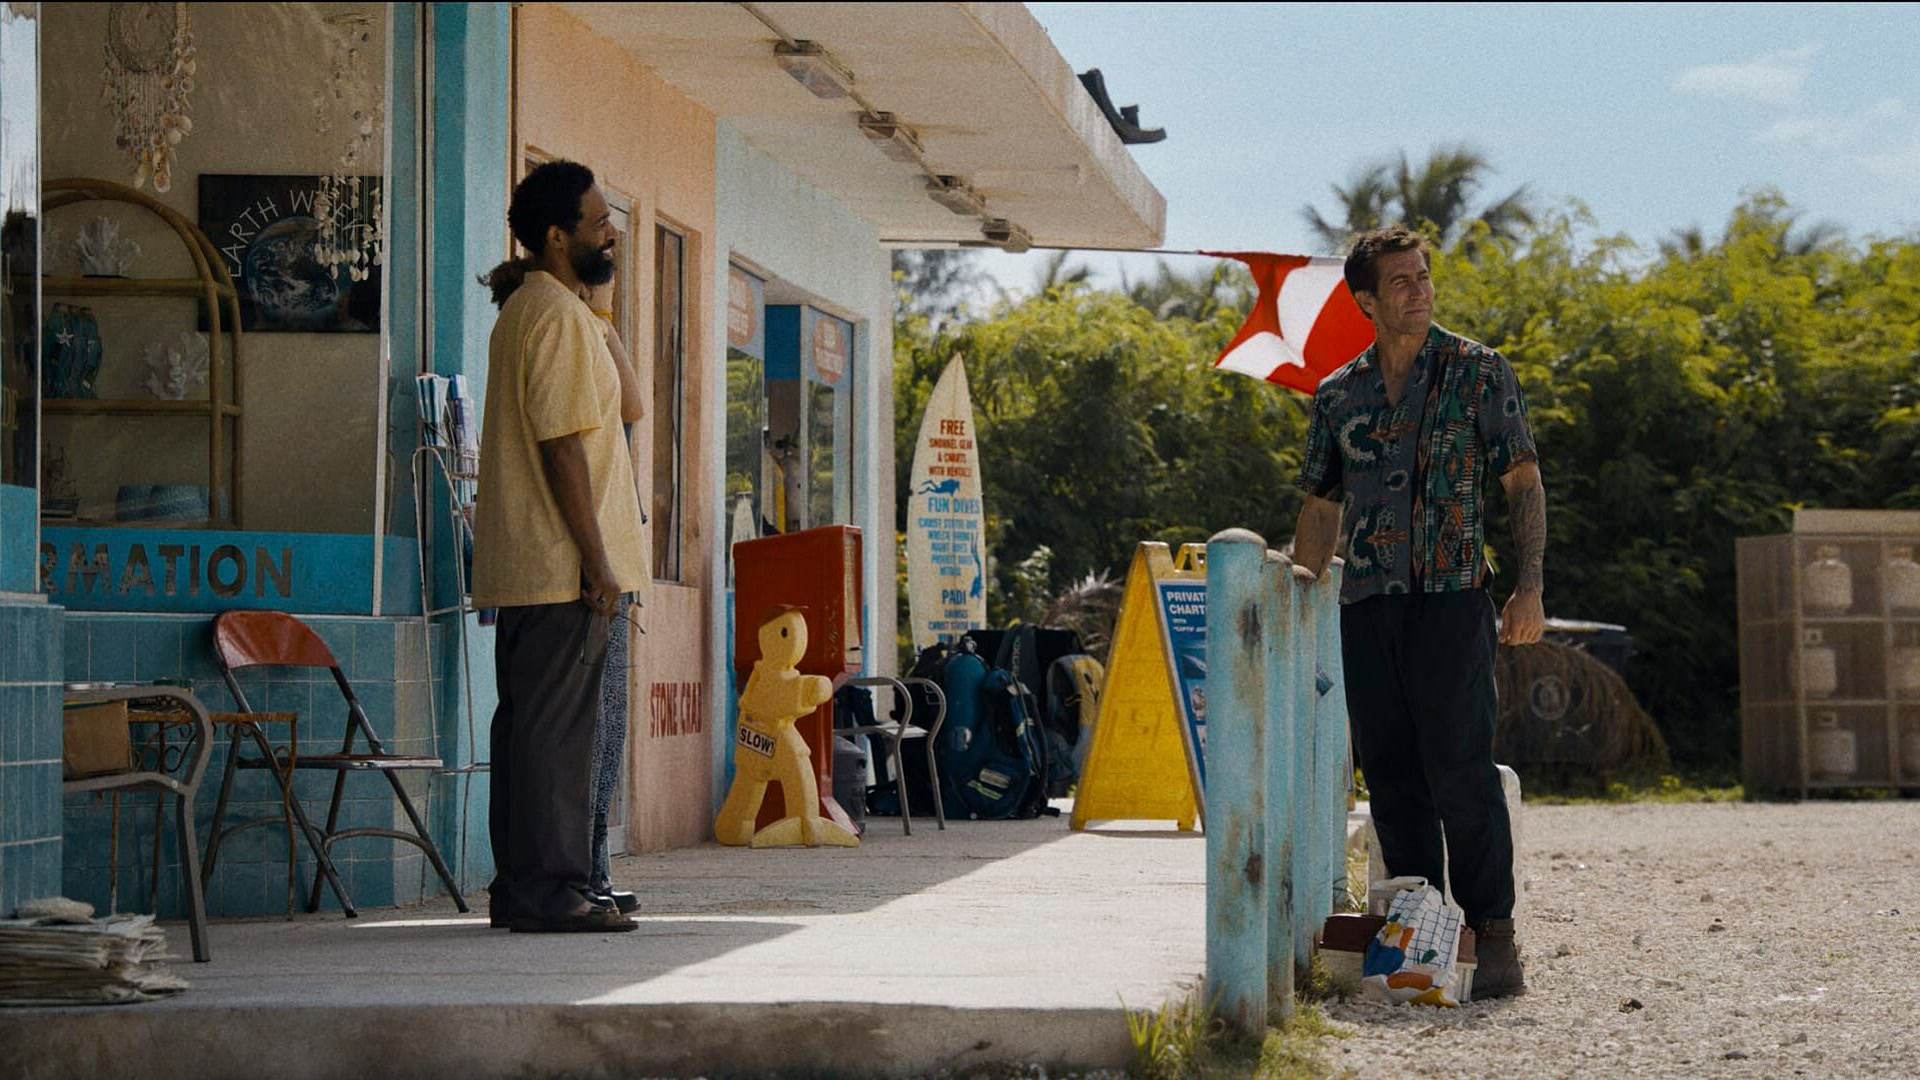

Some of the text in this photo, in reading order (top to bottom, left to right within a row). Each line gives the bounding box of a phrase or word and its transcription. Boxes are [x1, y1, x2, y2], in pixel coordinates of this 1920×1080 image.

[940, 419, 965, 435] FREE
[928, 497, 980, 514] FUN DIVES
[942, 589, 966, 605] PADI
[1166, 591, 1207, 603] PRIVAT
[1169, 604, 1207, 615] CHART
[651, 682, 677, 738] STONE
